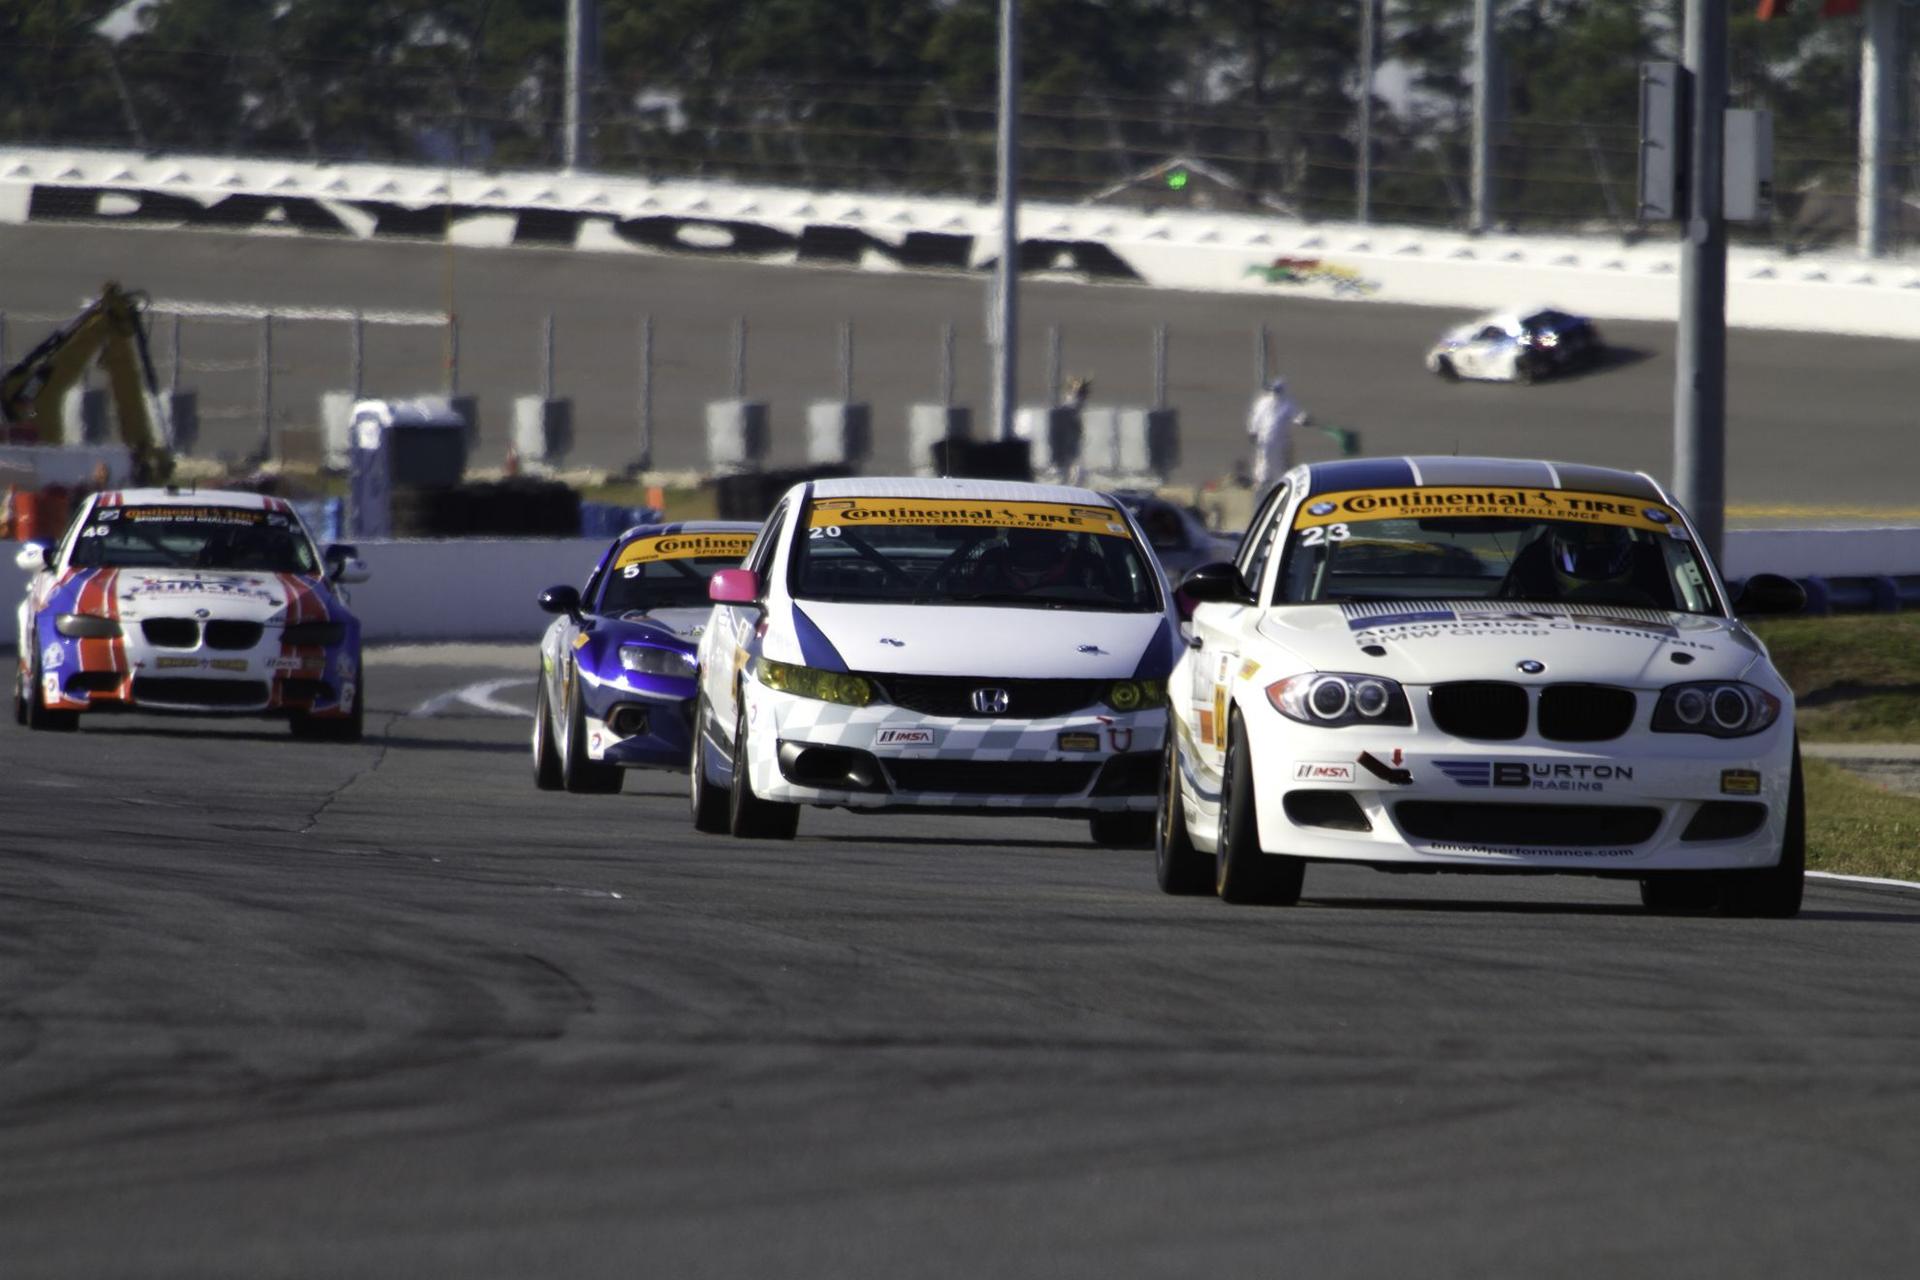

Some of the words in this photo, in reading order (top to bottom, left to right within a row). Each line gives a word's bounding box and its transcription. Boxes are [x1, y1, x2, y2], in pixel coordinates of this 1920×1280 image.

[28, 183, 1148, 286] DAYTONA
[1342, 491, 1527, 513] Continental
[1564, 498, 1637, 517] TIRE
[1400, 504, 1498, 515] SPORTSCAR
[1503, 506, 1600, 520] CHALLENGE
[840, 507, 993, 521] Continental
[1024, 512, 1083, 526] TIRE
[83, 525, 110, 539] 46
[809, 526, 842, 540] 20
[1301, 522, 1350, 547] 23
[624, 563, 640, 579] 5
[1355, 620, 1539, 638] Automotive
[1549, 622, 1715, 651] Chemicals
[1356, 629, 1441, 646] BMW
[1450, 628, 1551, 637] Group
[894, 731, 931, 743] IMSA
[1313, 766, 1350, 778] IMSA
[1493, 762, 1634, 787] BURTON
[1532, 780, 1604, 792] RACING
